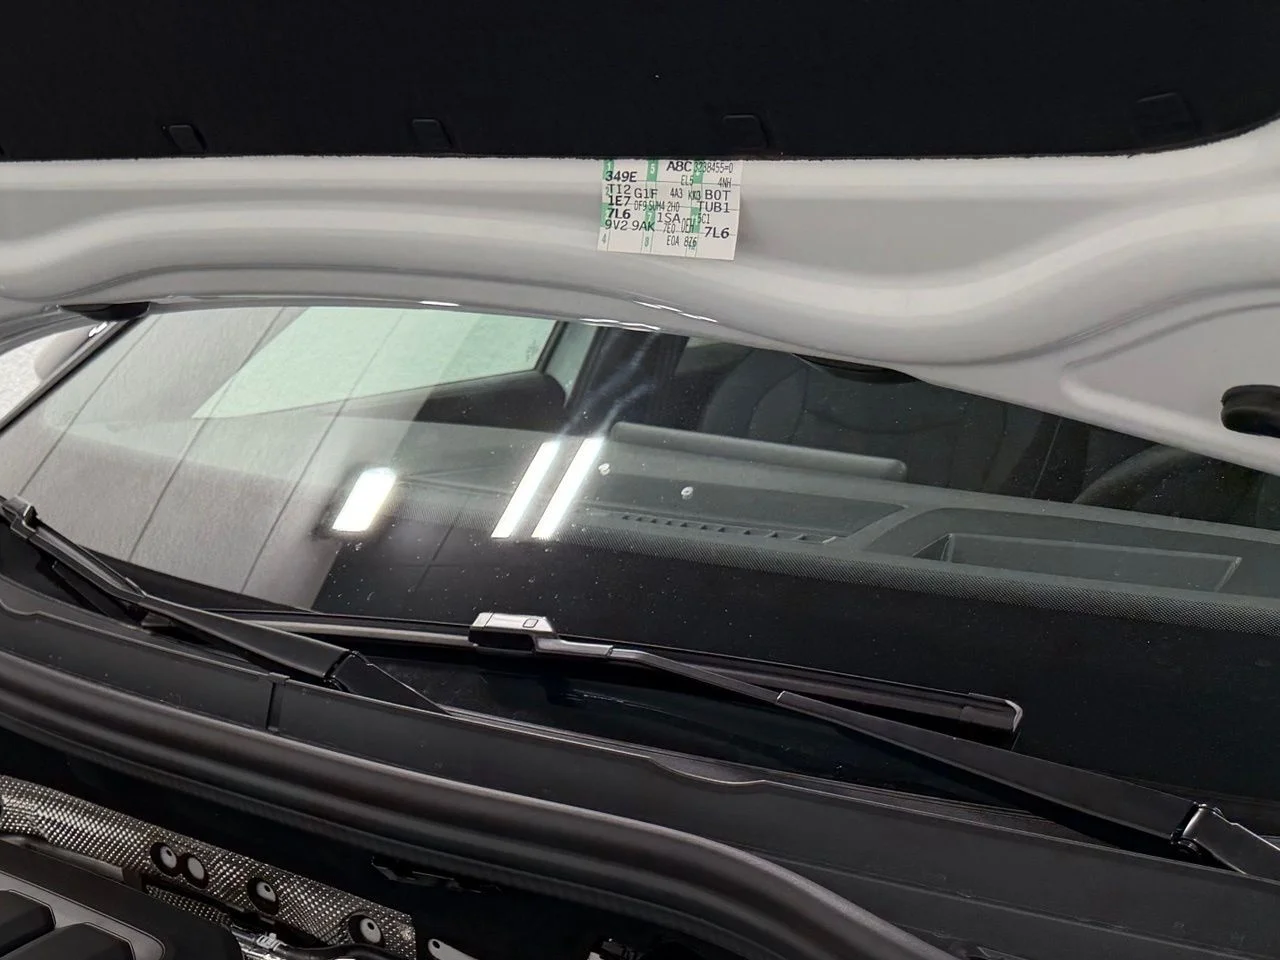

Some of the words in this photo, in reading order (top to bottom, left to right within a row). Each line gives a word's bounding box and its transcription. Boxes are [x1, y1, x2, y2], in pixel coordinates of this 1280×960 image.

[605, 170, 638, 182] 349E
[608, 195, 632, 207] 1E7
[606, 207, 631, 219] 7L6
[604, 218, 628, 230] 9V2
[631, 219, 656, 231] 9AK
[704, 226, 730, 239] 7L6
